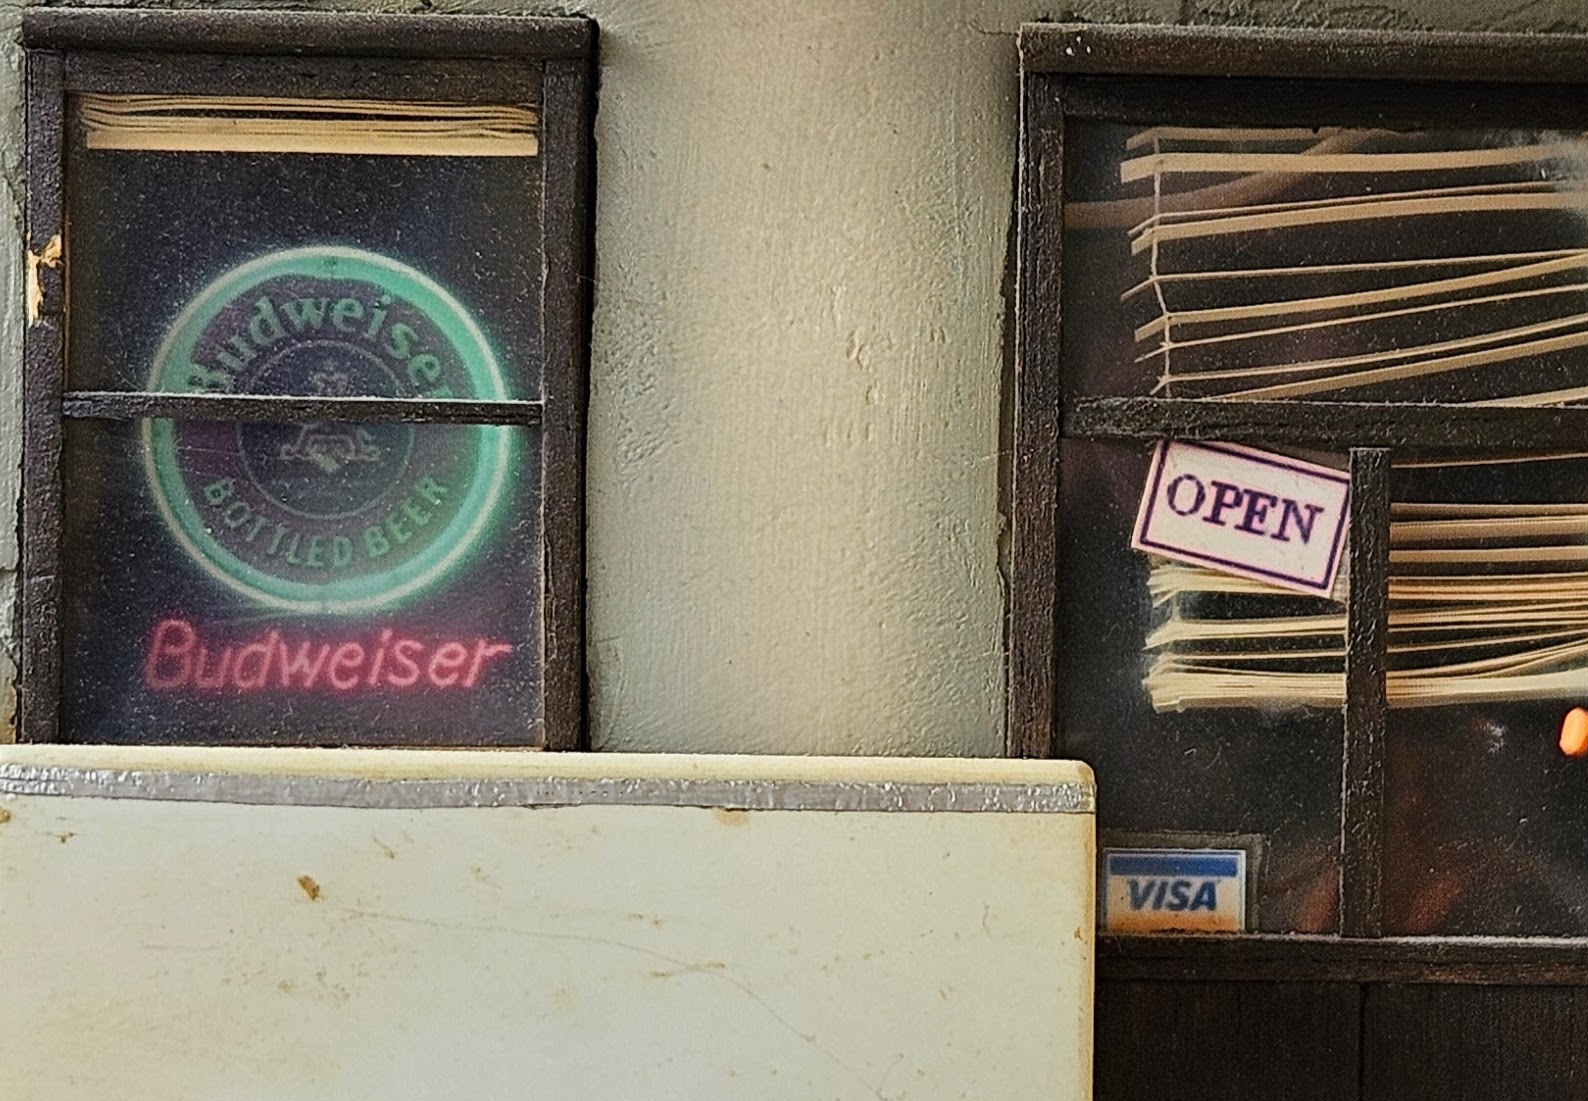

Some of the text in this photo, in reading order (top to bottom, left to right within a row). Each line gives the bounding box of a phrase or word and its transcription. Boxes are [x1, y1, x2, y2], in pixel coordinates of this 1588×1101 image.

[203, 475, 448, 569] BOTTLED BEER
[1167, 474, 1324, 544] OPEN
[145, 618, 513, 690] Budweiser
[1128, 879, 1218, 911] VISA
